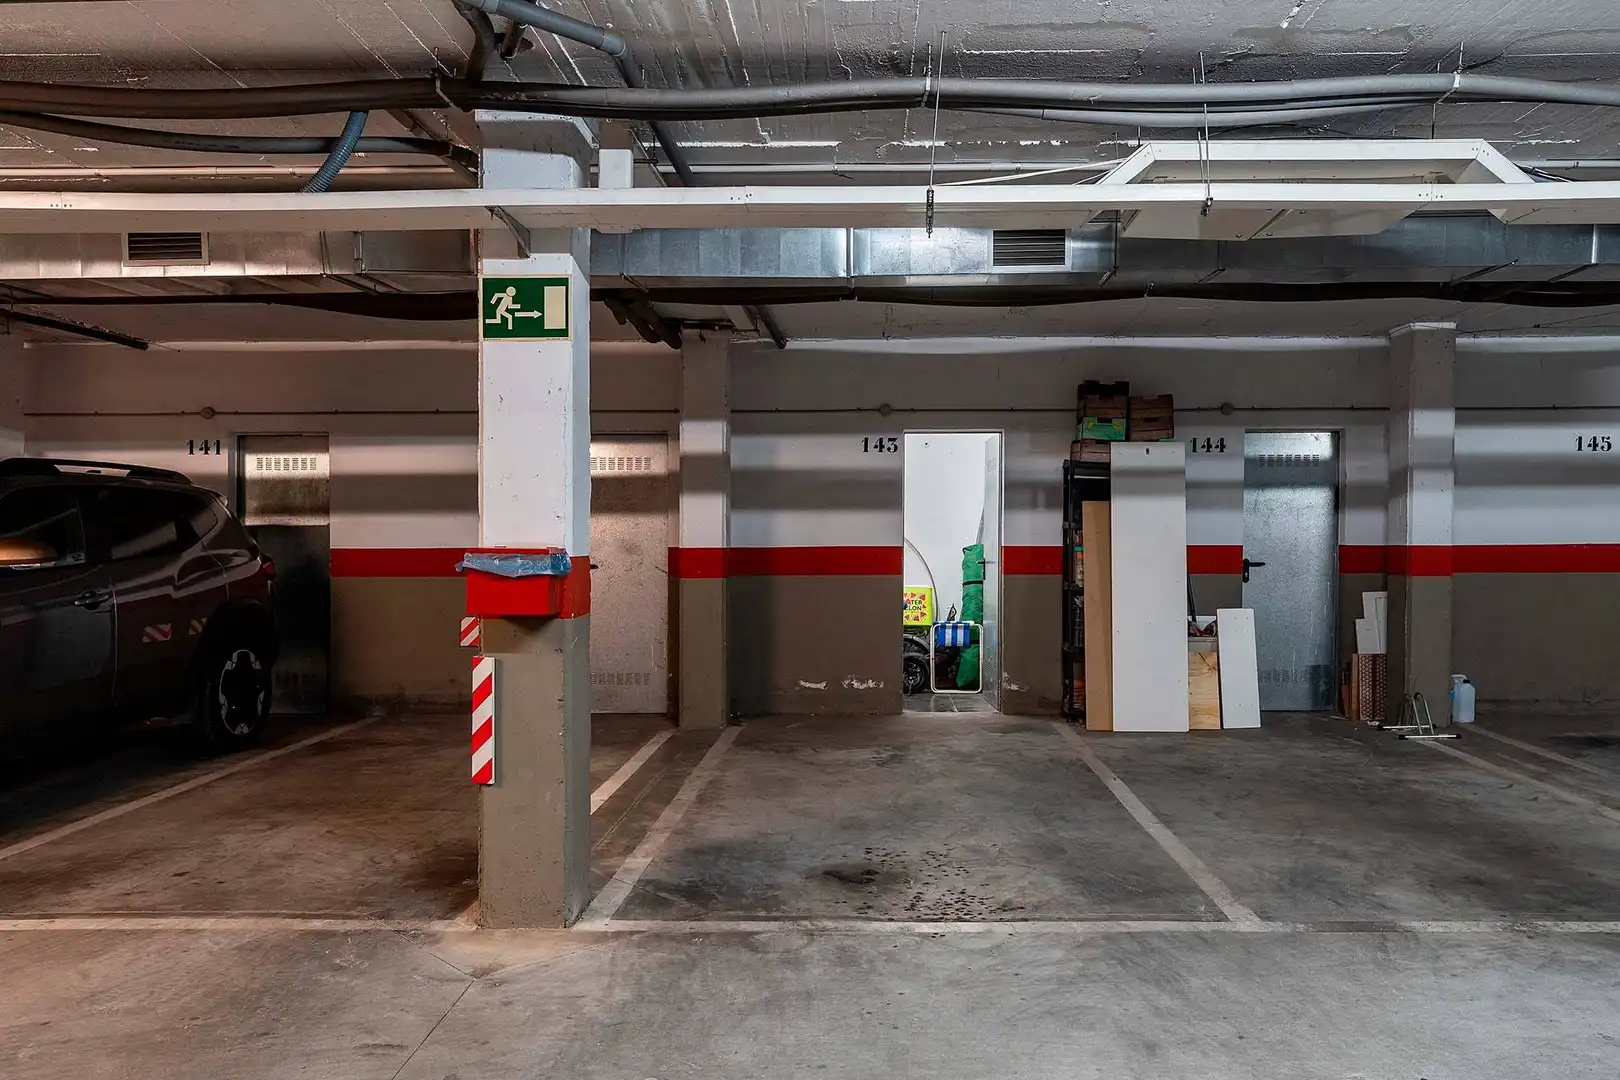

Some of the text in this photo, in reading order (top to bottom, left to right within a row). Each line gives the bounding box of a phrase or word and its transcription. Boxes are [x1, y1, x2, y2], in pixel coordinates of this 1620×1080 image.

[186, 439, 222, 456] 141
[861, 437, 899, 453] 143
[1189, 437, 1226, 453] 144
[1575, 435, 1612, 452] 145
